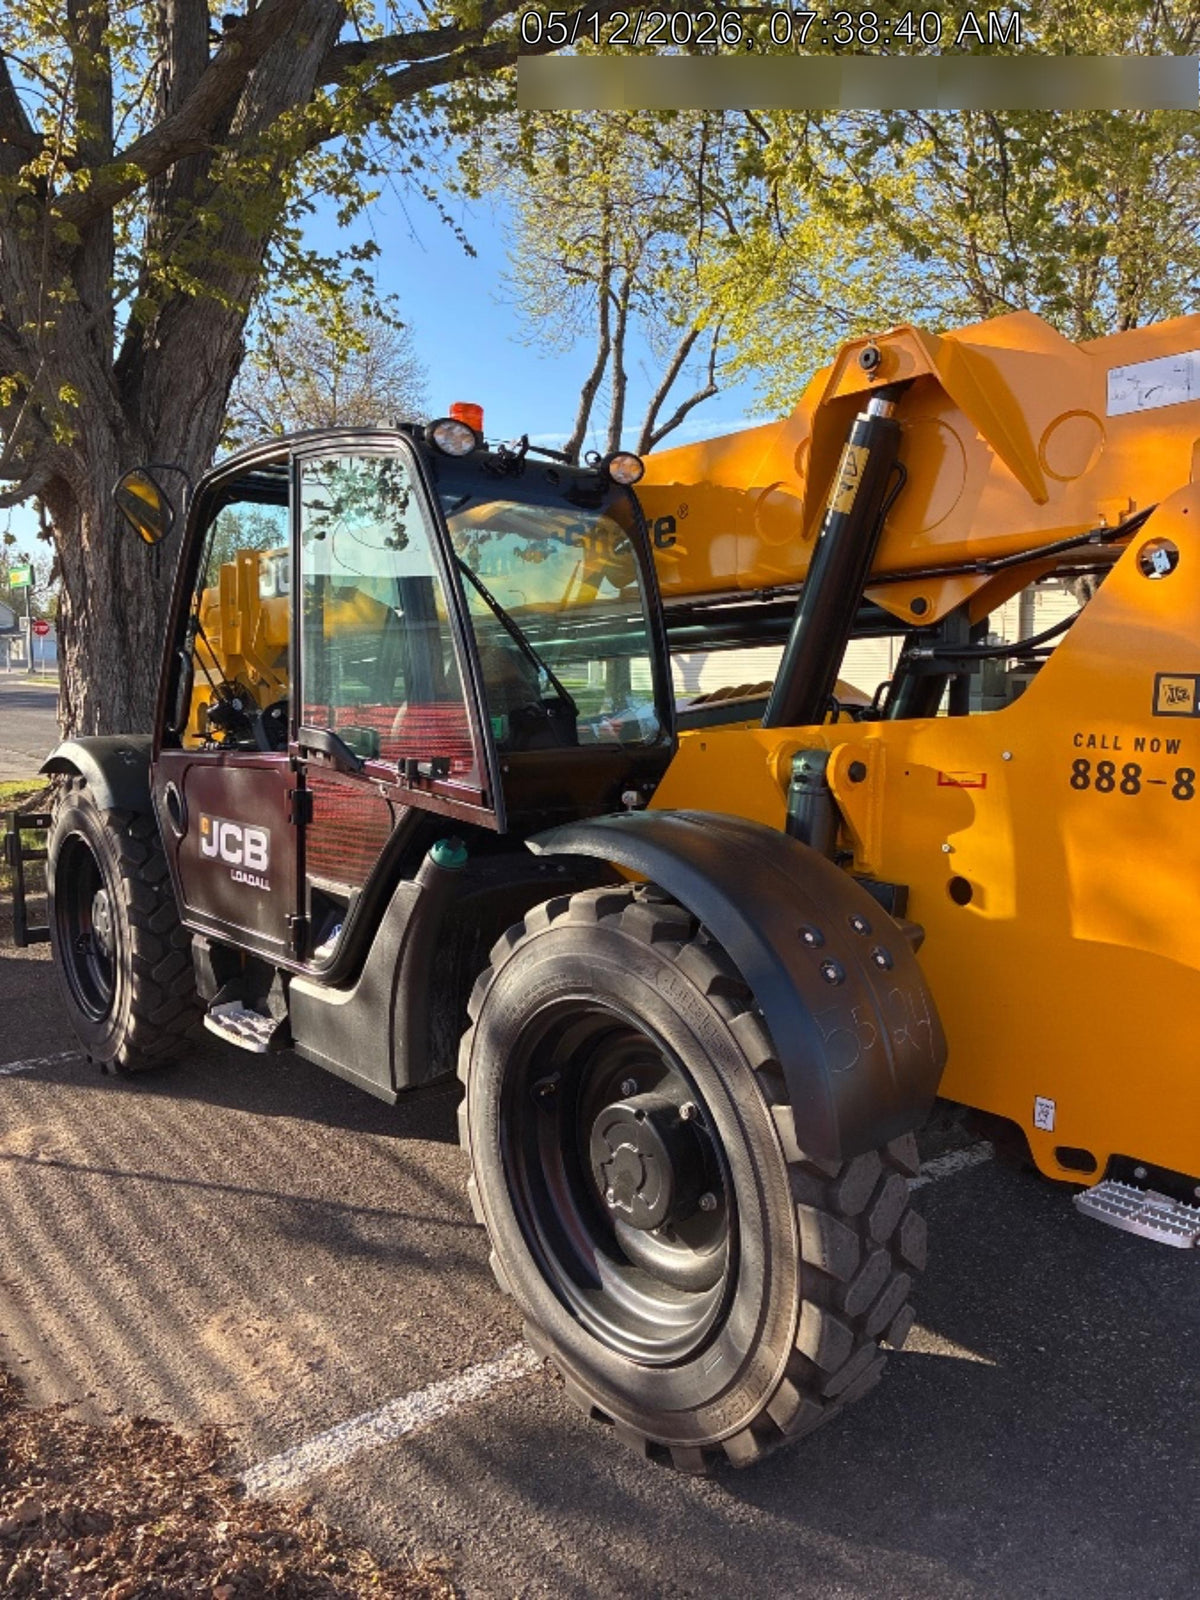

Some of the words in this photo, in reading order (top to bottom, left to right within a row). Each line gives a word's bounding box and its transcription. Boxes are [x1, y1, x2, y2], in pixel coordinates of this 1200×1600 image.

[1073, 732, 1122, 751] CALL
[1134, 737, 1181, 754] NOW
[202, 820, 269, 872] JCB
[230, 868, 271, 891] LOADALL
